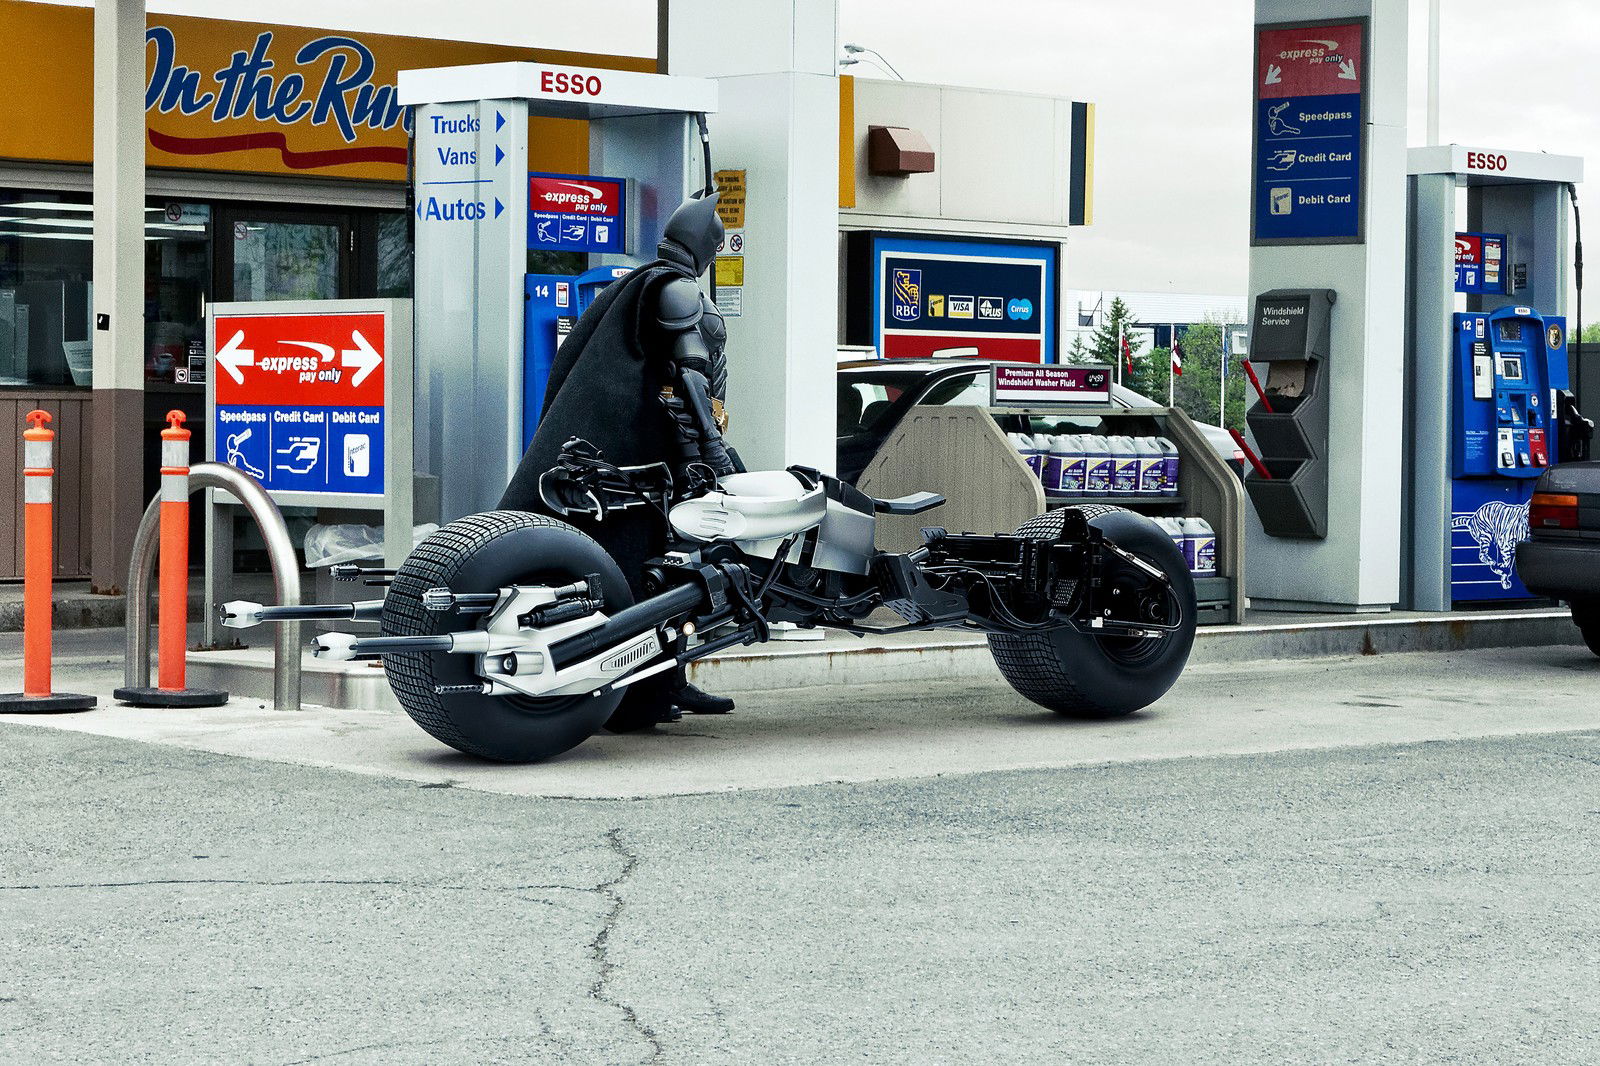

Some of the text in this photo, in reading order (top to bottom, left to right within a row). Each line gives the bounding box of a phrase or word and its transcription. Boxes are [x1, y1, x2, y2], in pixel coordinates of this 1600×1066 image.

[1280, 48, 1325, 61] express
[1325, 54, 1344, 64] only
[145, 26, 213, 115] On
[211, 31, 313, 124] the
[540, 71, 602, 96] ESSO
[1299, 111, 1352, 122] Speedpass
[430, 113, 481, 134] Trucks
[437, 147, 477, 166] Vans
[1299, 151, 1352, 164] Credit Card
[1467, 151, 1507, 171] ESSO
[545, 191, 590, 205] express
[1298, 194, 1351, 205] Debit Card
[425, 196, 486, 221] Autos
[575, 203, 608, 213] pay only
[534, 212, 559, 220] Speedpass
[535, 285, 549, 297] 14
[896, 305, 918, 317] RBC
[952, 302, 970, 312] VISA
[986, 308, 1002, 318] PLUS
[1010, 304, 1029, 314] Cirrus
[1263, 307, 1304, 315] Windshield
[1262, 317, 1290, 325] Service
[1462, 320, 1472, 331] 12
[261, 356, 318, 374] express
[299, 371, 342, 384] pay only
[1005, 368, 1069, 379] Premium All Season
[998, 377, 1076, 387] Windshield Washer Fluid
[220, 410, 267, 423] Speedpass
[274, 411, 324, 423] Credit Card
[332, 411, 380, 424] Debit Card
